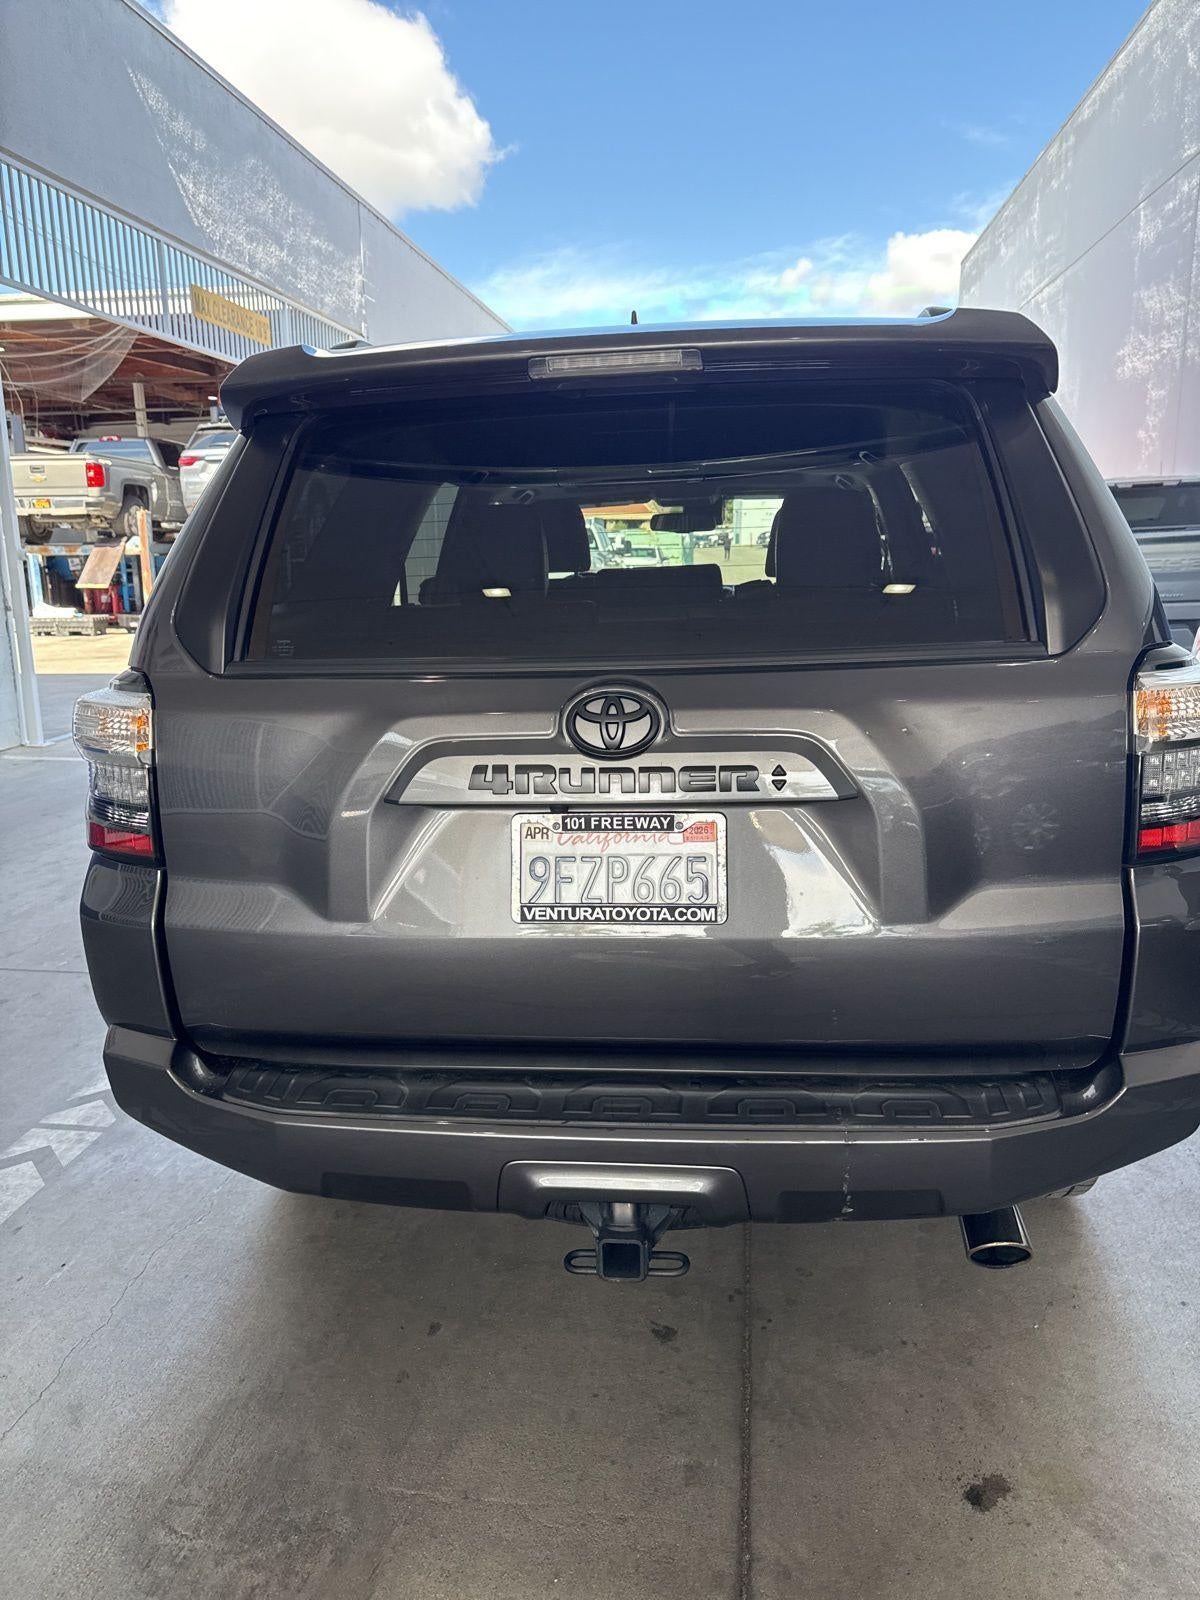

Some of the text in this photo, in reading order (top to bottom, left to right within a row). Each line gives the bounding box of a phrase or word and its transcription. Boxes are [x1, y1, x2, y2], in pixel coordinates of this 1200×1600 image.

[564, 816, 671, 830] 101 FREEWAY
[524, 826, 550, 840] APR
[529, 856, 709, 904] 9FZP665
[523, 905, 716, 922] VENTURATOYOTA.COM
